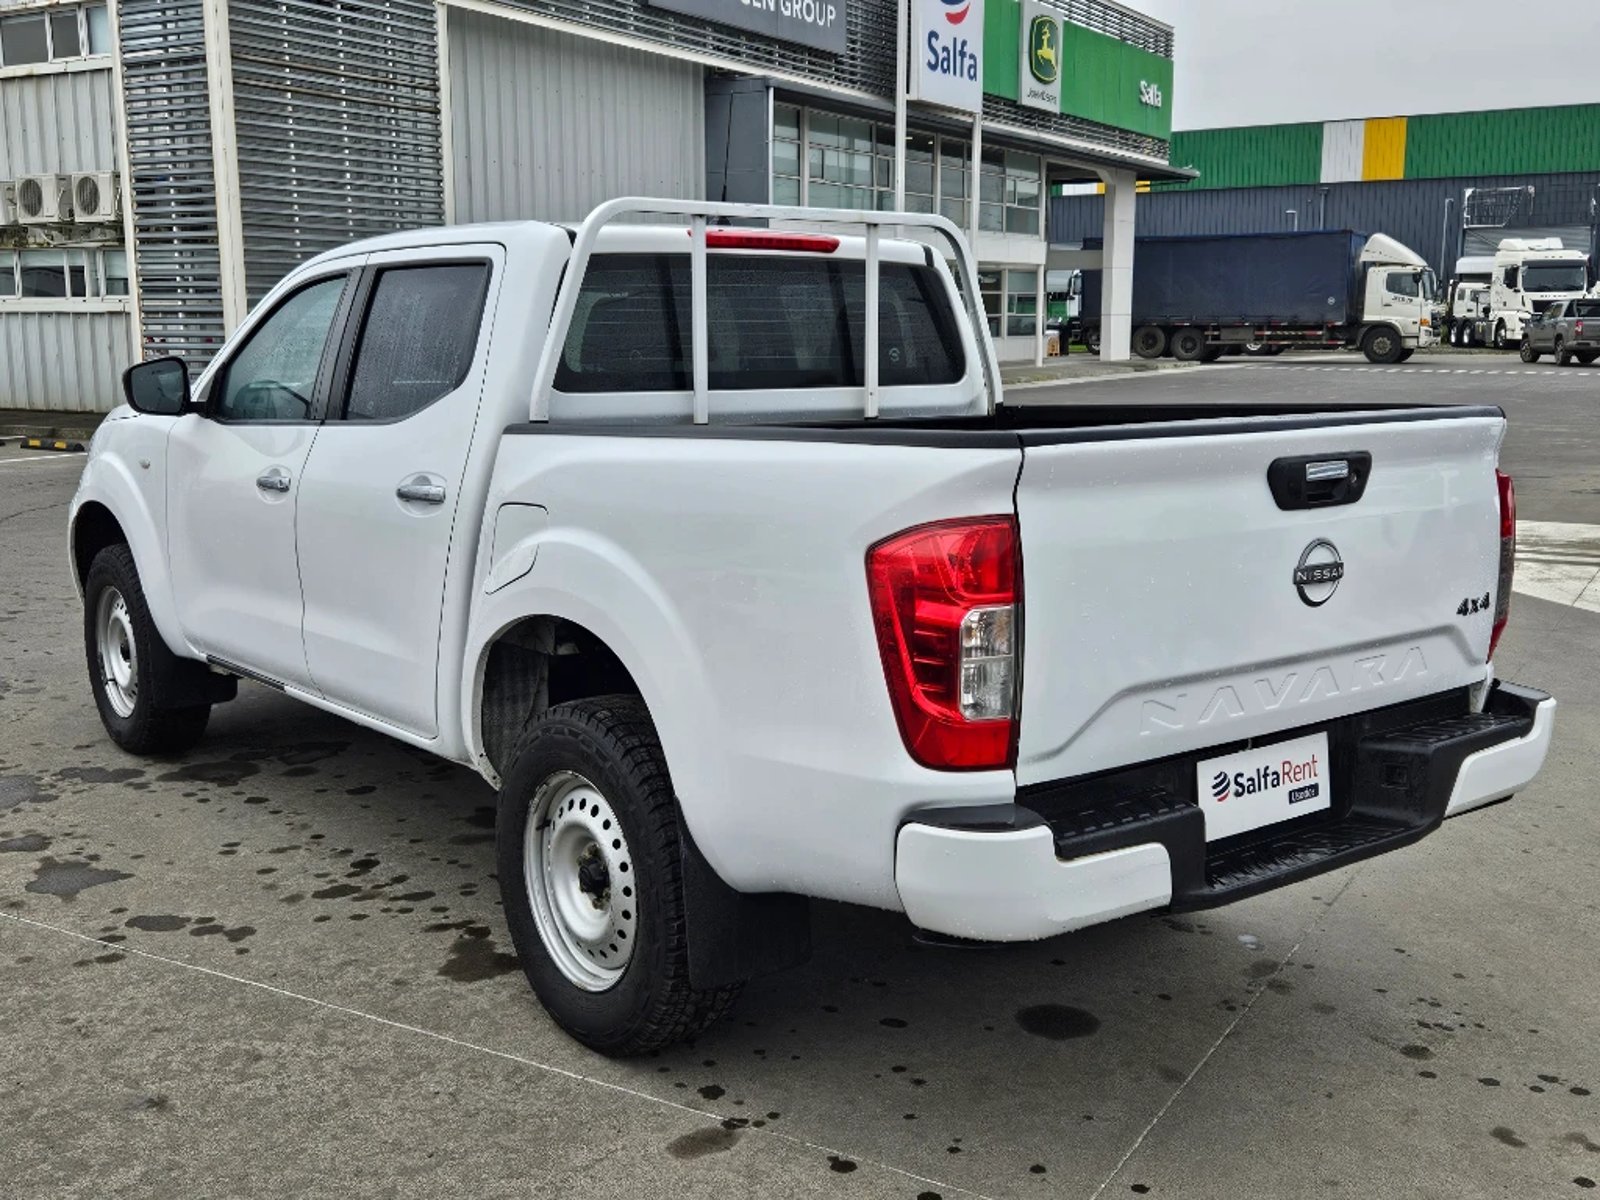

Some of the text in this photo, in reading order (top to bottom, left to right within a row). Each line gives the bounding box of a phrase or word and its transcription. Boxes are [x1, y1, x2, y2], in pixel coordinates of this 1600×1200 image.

[781, 0, 837, 28] GROUP
[926, 29, 978, 81] Salfa
[1456, 591, 1490, 616] 4x4
[1139, 646, 1428, 736] NAVARA
[1233, 754, 1319, 798] SalfaRent
